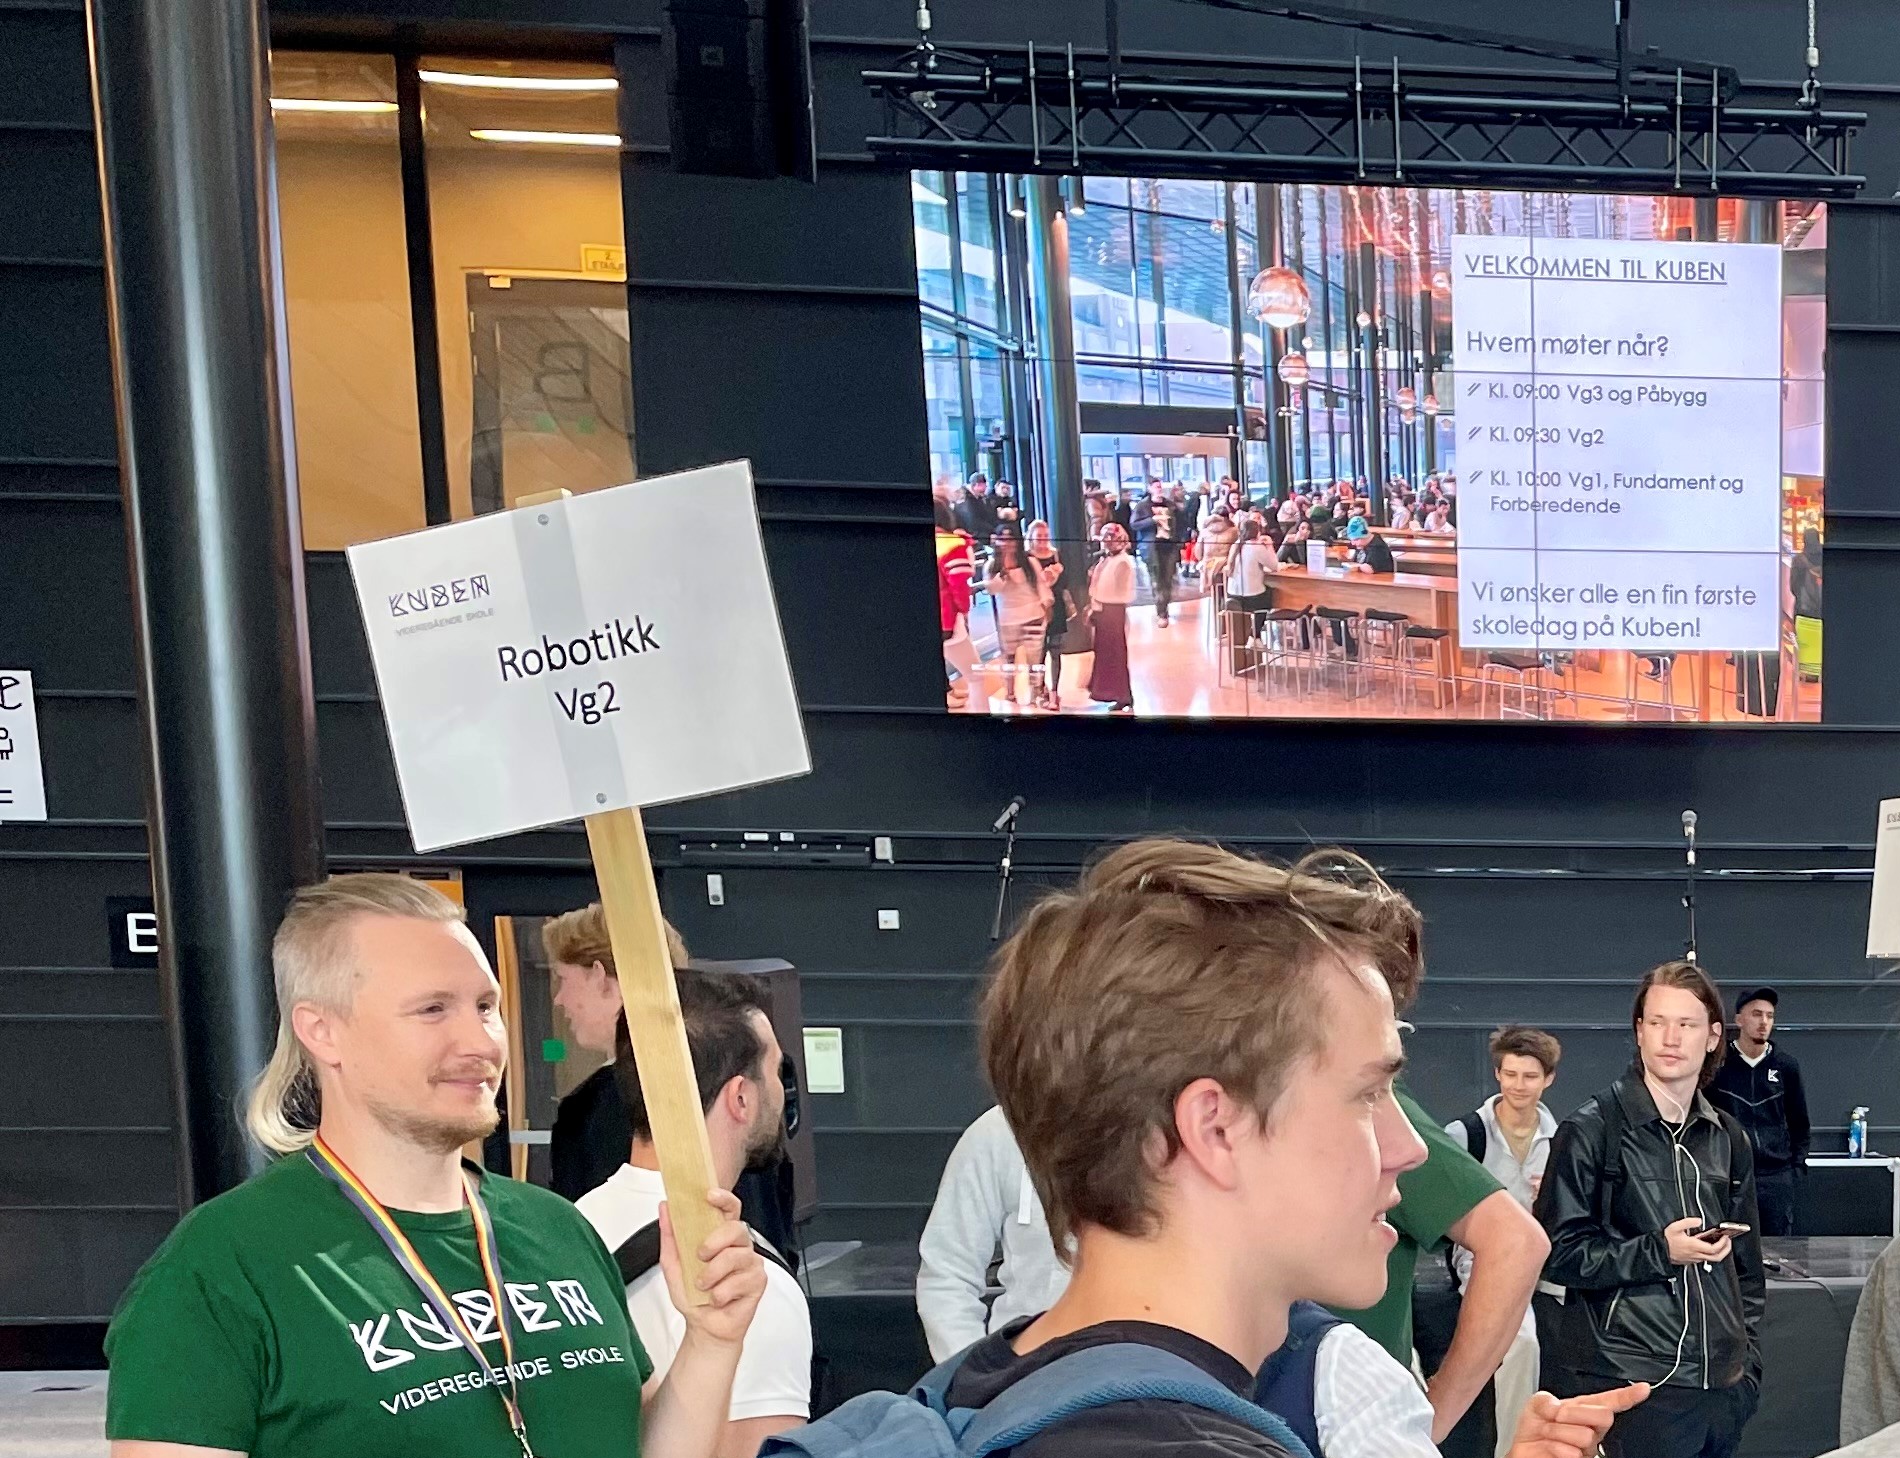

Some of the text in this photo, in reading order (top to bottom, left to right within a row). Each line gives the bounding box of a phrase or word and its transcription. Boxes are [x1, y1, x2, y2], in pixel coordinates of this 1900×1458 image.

[1465, 254, 1726, 281] VELKOMMEN TIL KUBEN
[1467, 331, 1669, 357] Hvem møter når?
[1488, 383, 1707, 406] Kl. 09:00 Vg3 og Påbygg
[1489, 427, 1604, 447] Kl. 09:30 Vg2
[1490, 471, 1743, 493] Kl. 10:00 Vg1, Fundament og
[1490, 496, 1620, 514] Forberedende
[388, 574, 491, 617] KUBEN
[1471, 581, 1757, 606] Vi ønsker alle en fin første
[1472, 614, 1701, 641] skoledag på Kuben!
[498, 615, 660, 682] Robotikk
[554, 681, 620, 725] Vg2
[127, 913, 158, 952] E
[349, 1280, 603, 1372] KUBEN
[561, 1346, 624, 1369] SKOLE
